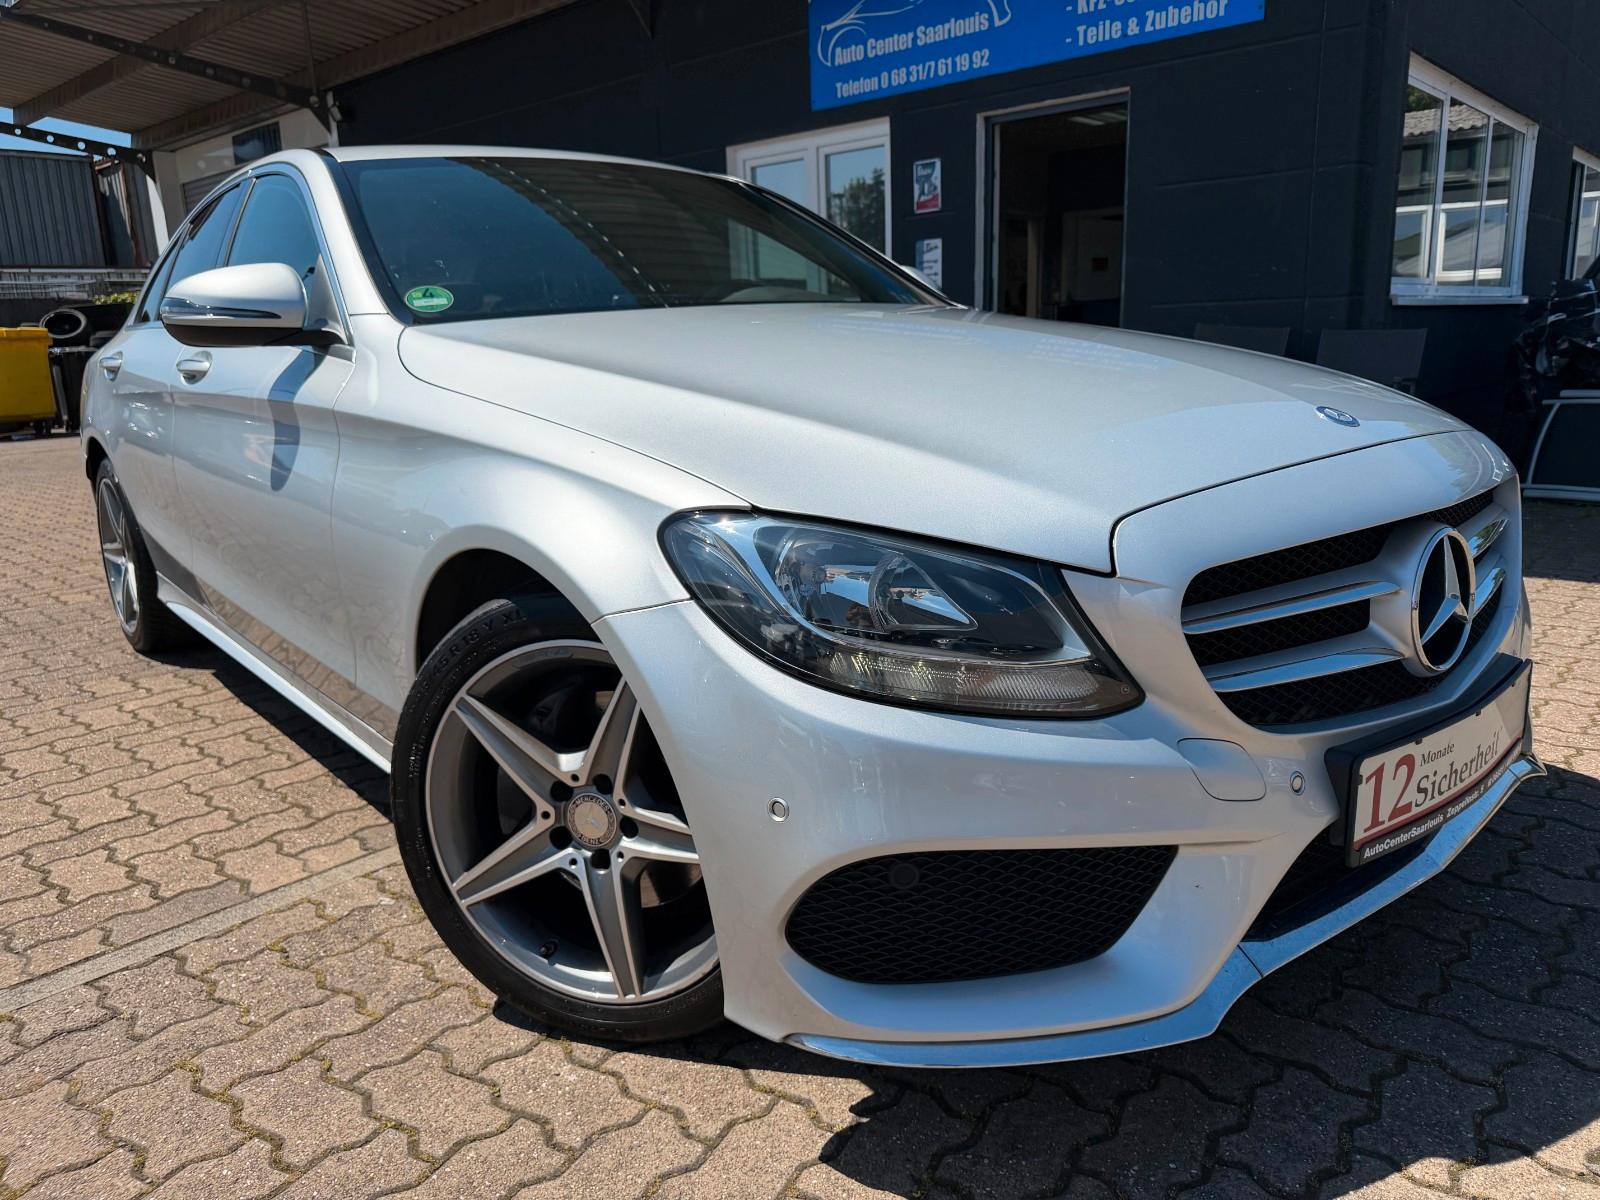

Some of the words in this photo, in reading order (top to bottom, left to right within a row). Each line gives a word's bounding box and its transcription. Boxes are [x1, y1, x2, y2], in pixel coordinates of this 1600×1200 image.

[834, 44, 864, 66] Auto
[867, 31, 914, 58] Center
[917, 11, 989, 46] Saarlouis
[1076, 20, 1122, 46] Teile
[1127, 16, 1140, 36] &
[835, 76, 878, 99] Telefon
[880, 71, 889, 89] 0
[891, 67, 907, 87] 68
[909, 60, 935, 83] 31/7
[937, 57, 951, 76] 61
[955, 53, 969, 73] 19
[972, 48, 990, 69] 92
[1414, 730, 1500, 808] Sicherheit
[1420, 743, 1455, 767] Monate
[1364, 754, 1415, 832] 12
[1363, 814, 1444, 859] AutoCenterSaarlouis
